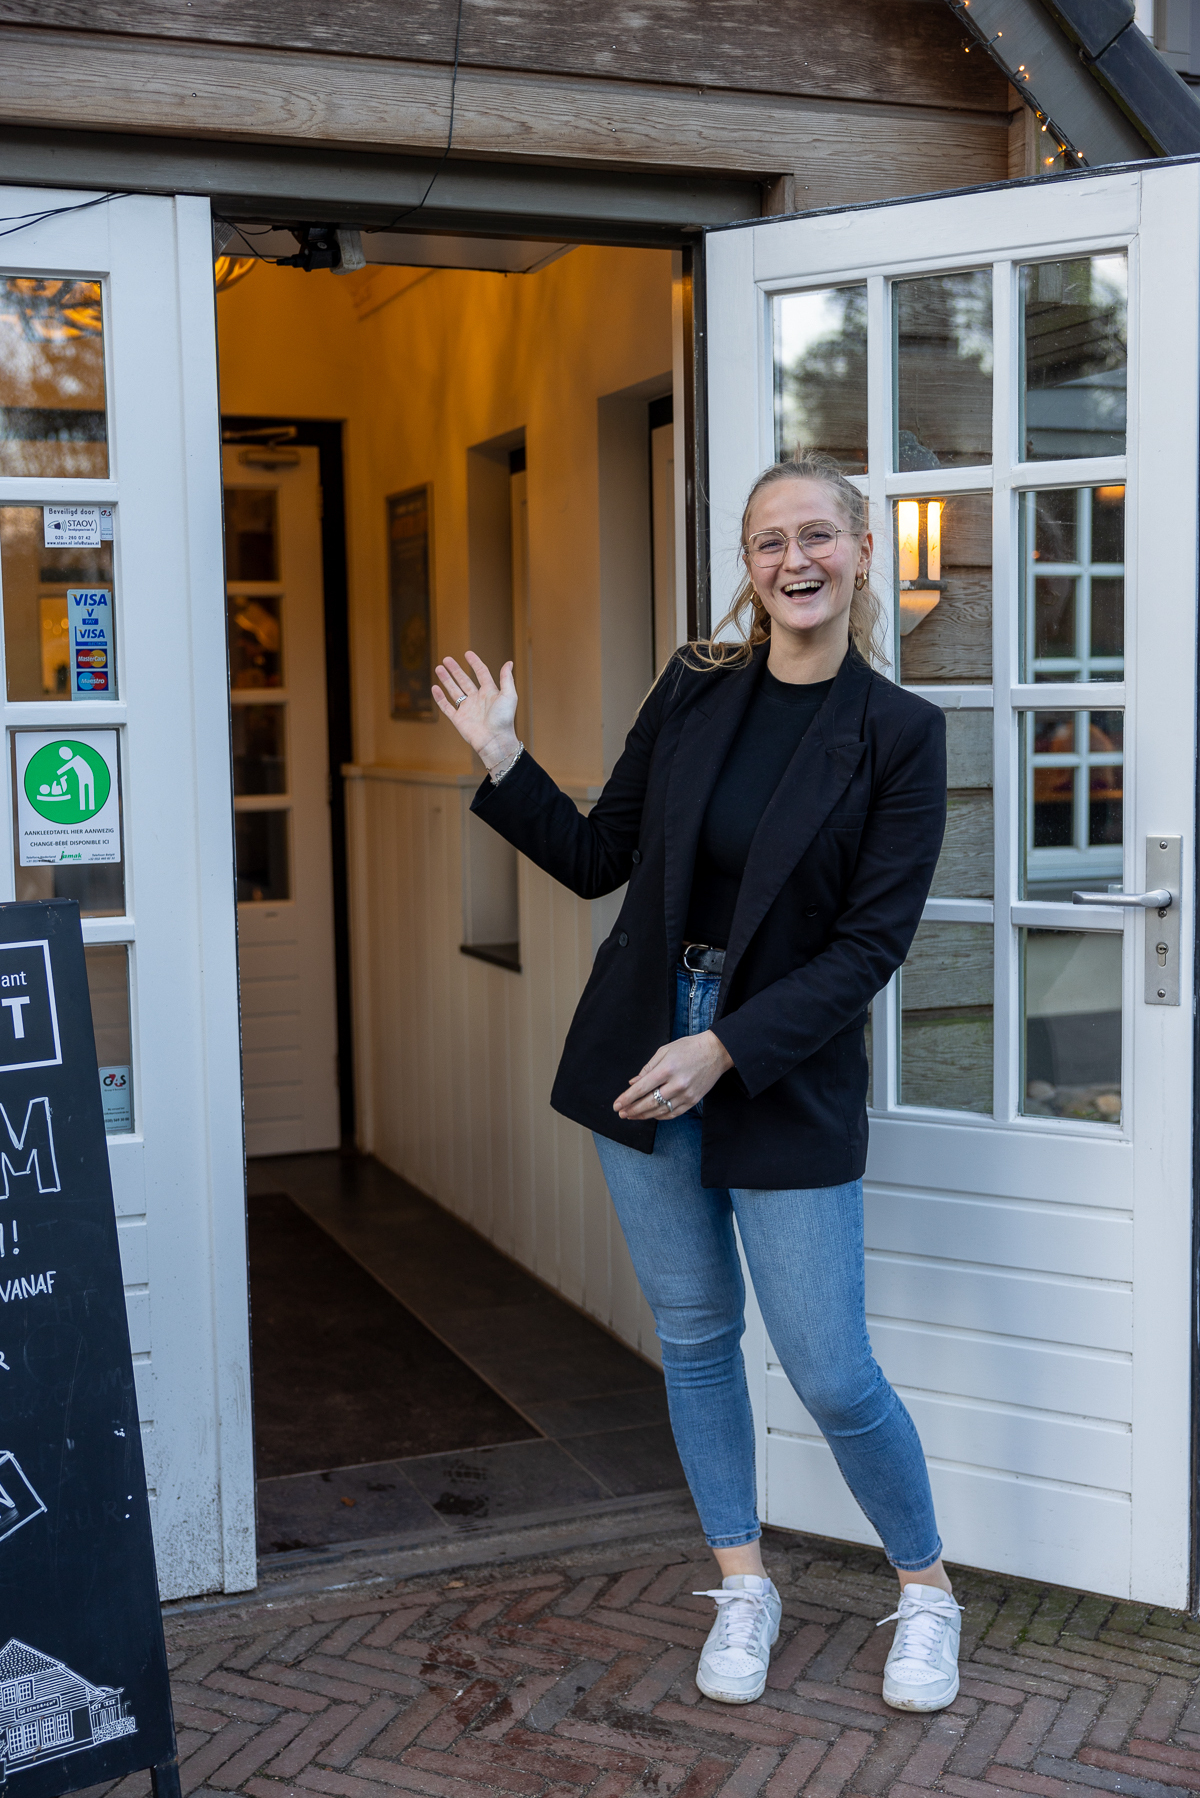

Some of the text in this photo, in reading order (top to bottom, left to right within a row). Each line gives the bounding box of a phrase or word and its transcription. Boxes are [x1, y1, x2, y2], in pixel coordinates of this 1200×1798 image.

[49, 508, 78, 516] Beveiligd
[68, 519, 93, 527] STAOV
[71, 594, 108, 606] VISA
[86, 608, 94, 617] V
[78, 629, 106, 639] VISA
[1, 971, 28, 987] ant
[1, 996, 30, 1039] T
[0, 1270, 57, 1302] VANAF
